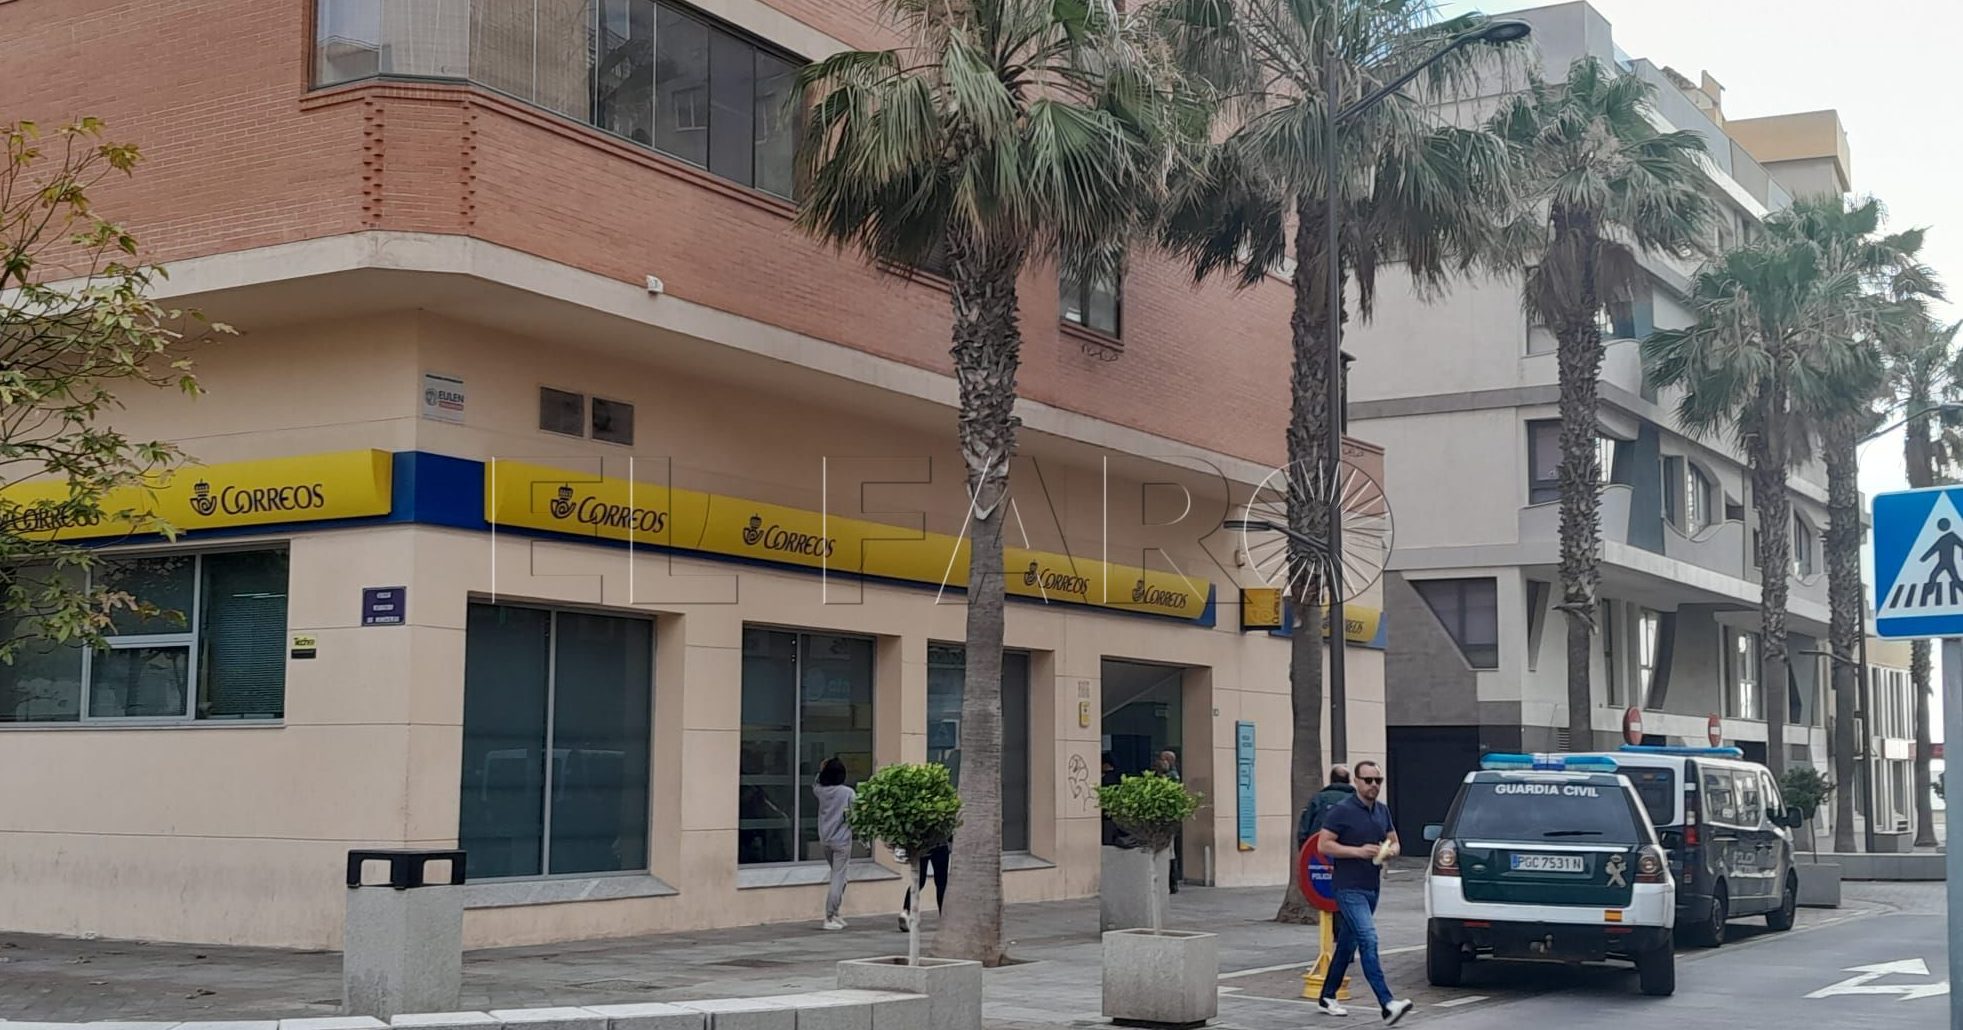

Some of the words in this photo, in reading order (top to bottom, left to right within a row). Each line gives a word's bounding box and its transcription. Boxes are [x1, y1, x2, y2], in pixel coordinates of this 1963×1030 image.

[438, 390, 465, 403] EULEN
[221, 483, 325, 515] CORREOS
[577, 496, 668, 533] CORREOS
[763, 524, 837, 558] CORREOS
[1039, 568, 1090, 595] CORREOS
[1143, 585, 1189, 609] CORREOS
[1495, 783, 1559, 795] GUARDIA
[1563, 785, 1599, 797] CIVIL
